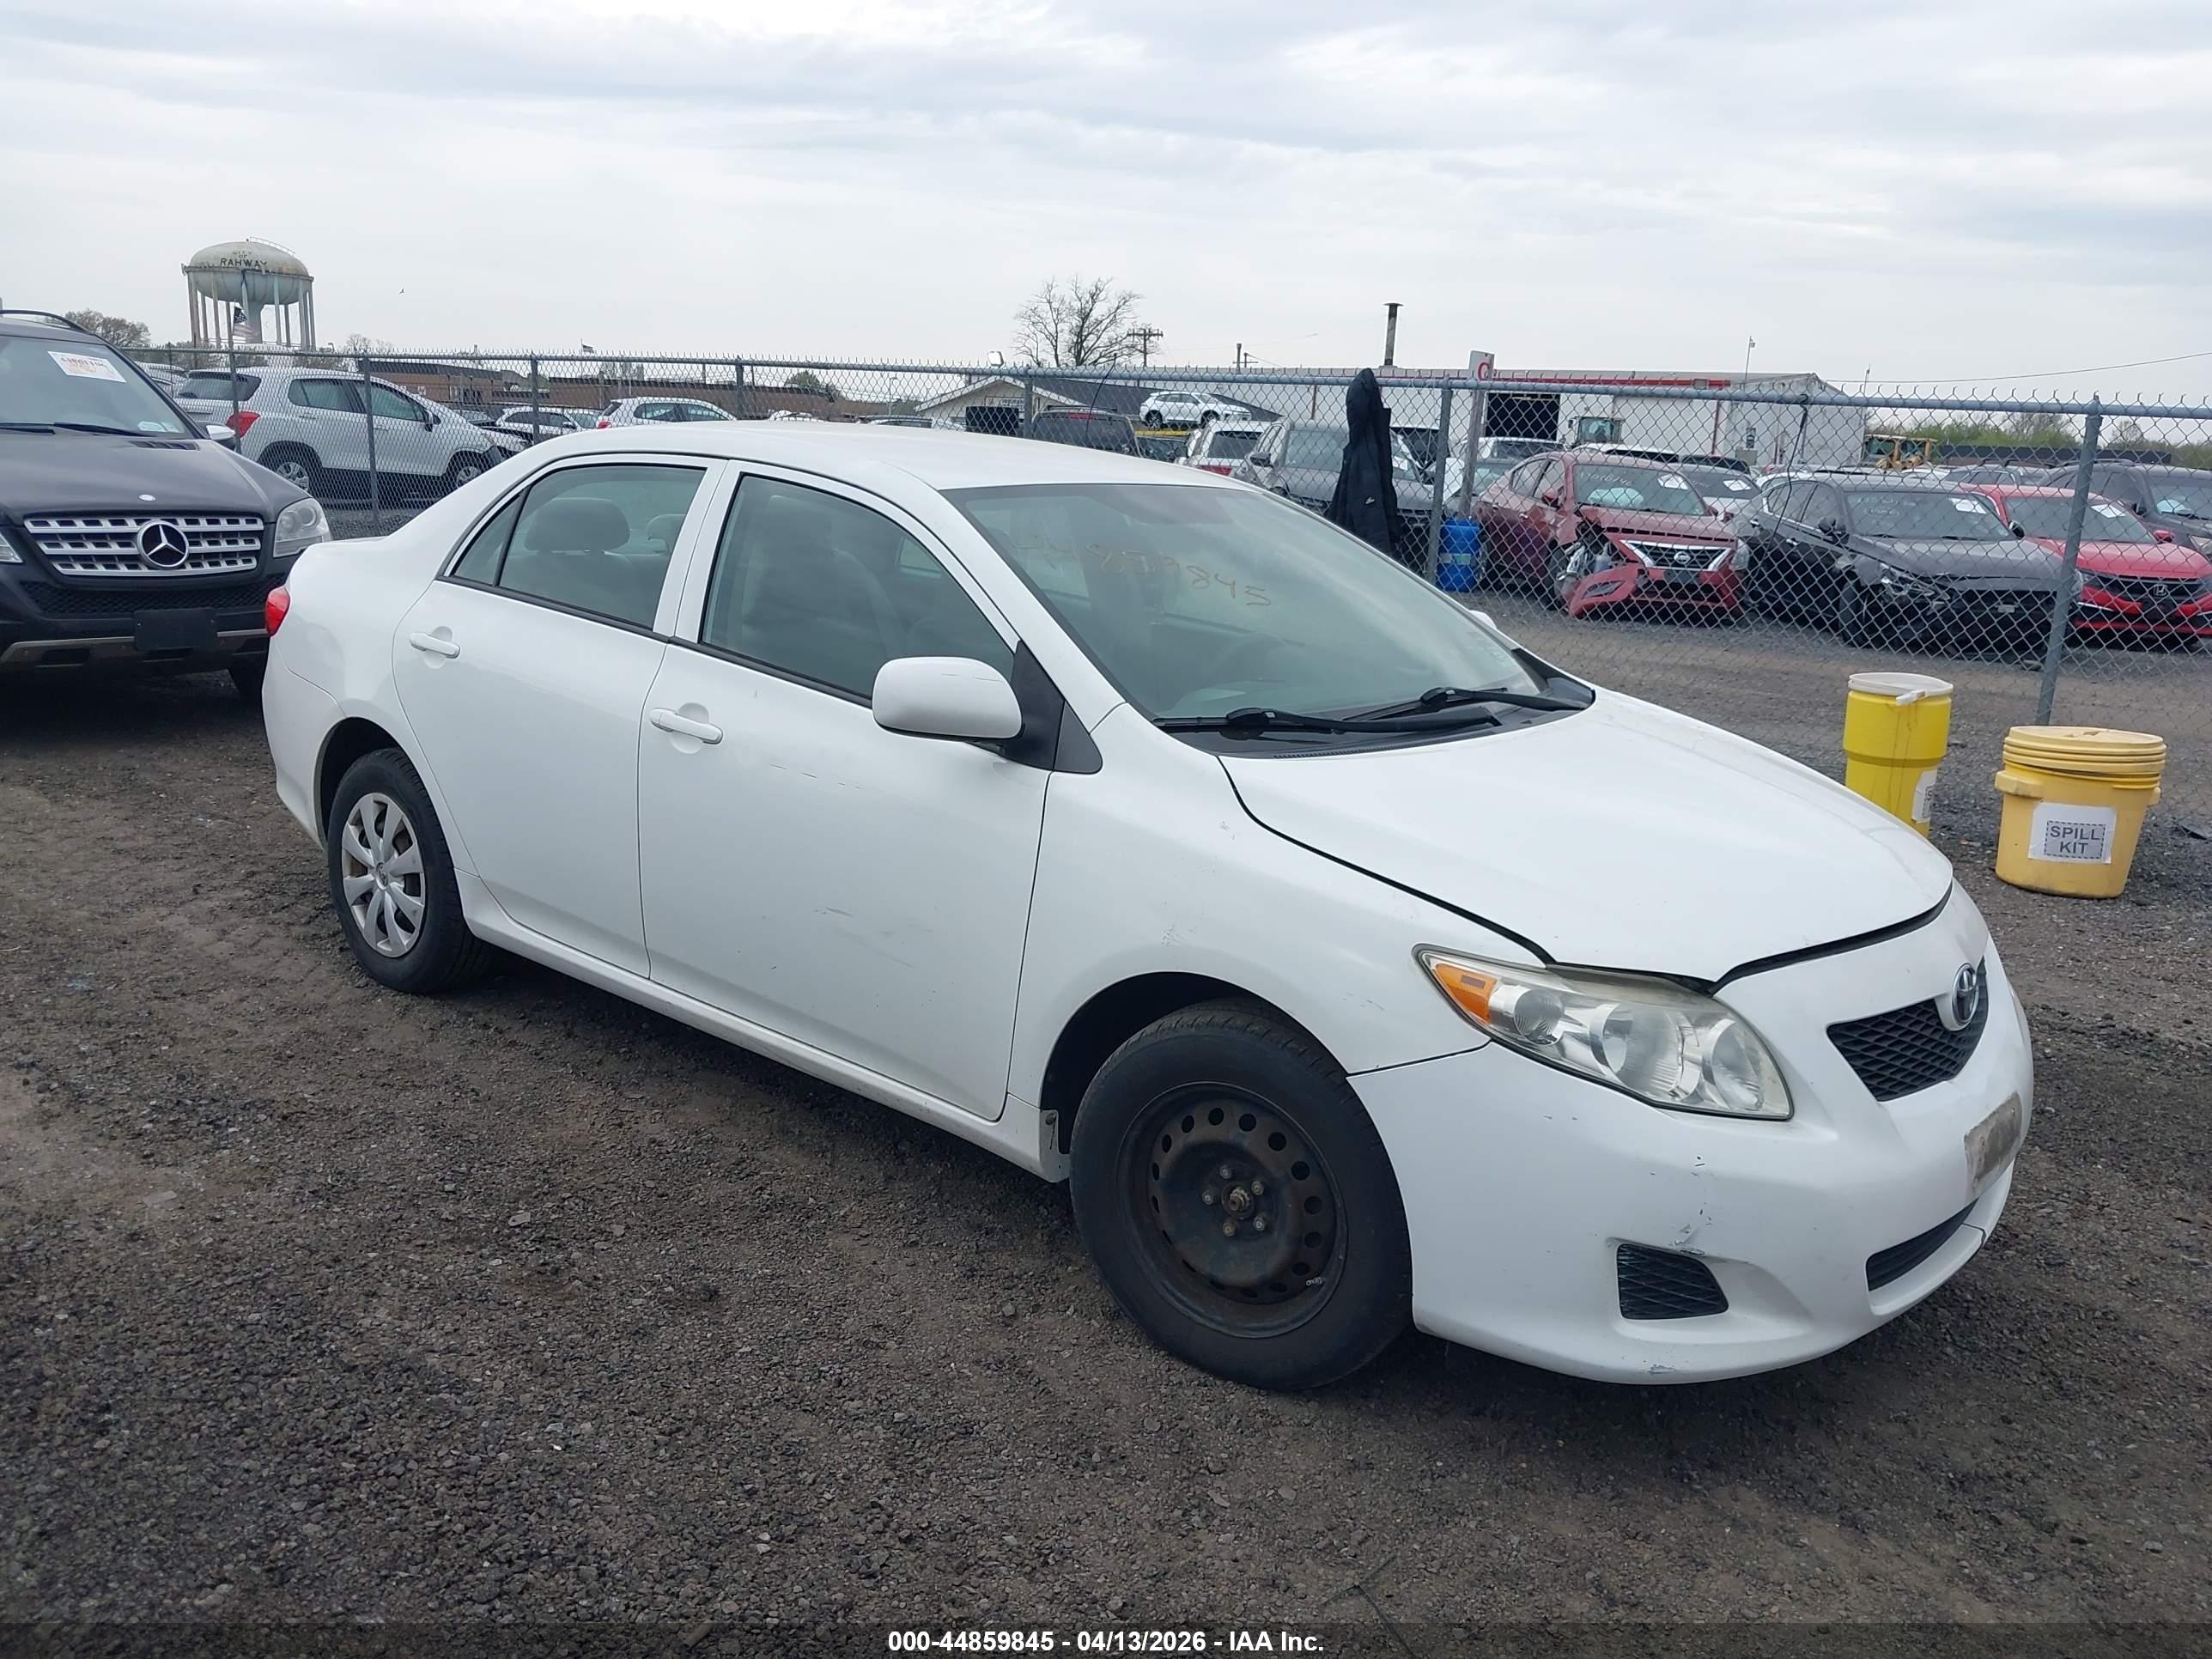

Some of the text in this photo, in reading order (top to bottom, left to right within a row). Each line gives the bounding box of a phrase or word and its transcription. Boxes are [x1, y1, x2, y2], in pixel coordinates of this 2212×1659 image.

[220, 258, 267, 269] RAHWAY
[2050, 825, 2100, 841] SPILL
[2059, 842, 2089, 854] KIT
